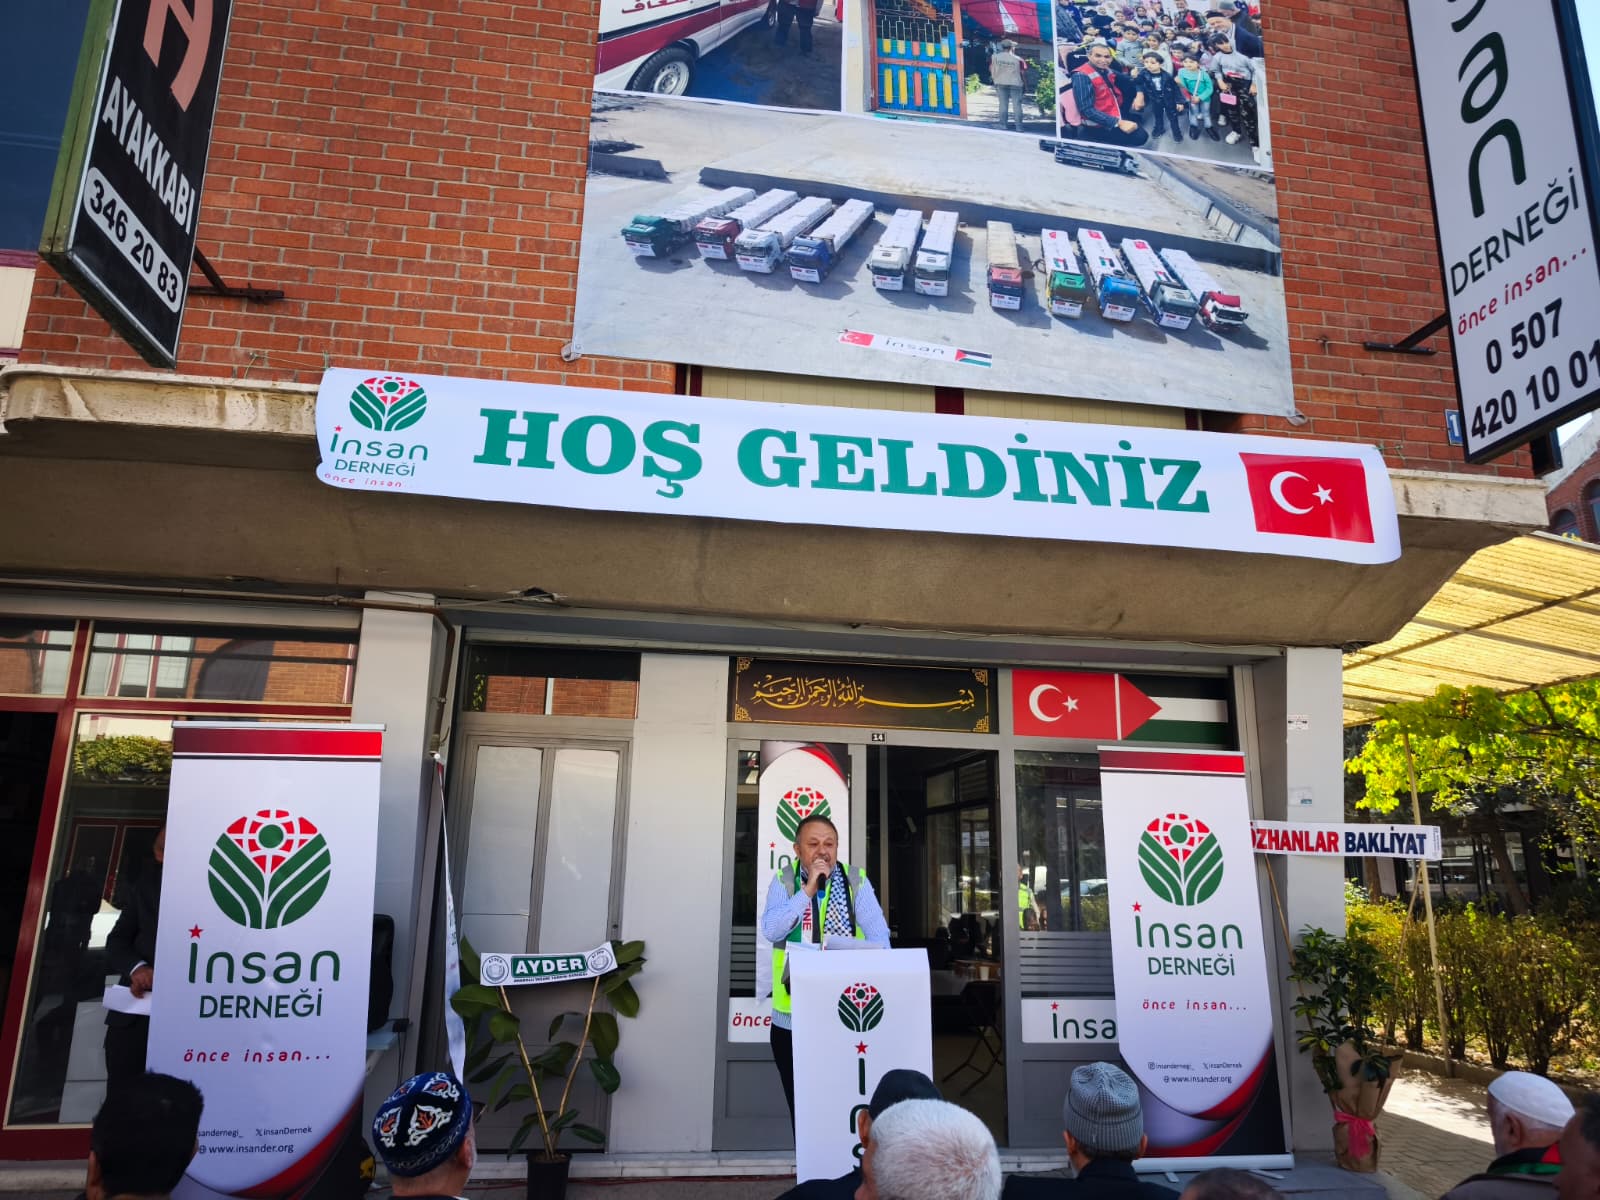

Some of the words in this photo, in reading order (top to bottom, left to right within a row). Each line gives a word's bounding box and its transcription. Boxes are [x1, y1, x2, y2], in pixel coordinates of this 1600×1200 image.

[1450, 0, 1526, 218] an
[103, 76, 196, 235] AYAKKABI
[90, 179, 128, 243] 346
[130, 230, 154, 274] 20
[157, 261, 178, 304] 83
[1450, 167, 1579, 296] DERNEĞİ
[1458, 297, 1497, 336] önce
[1486, 339, 1502, 375] 0
[1511, 297, 1562, 360] 507
[1471, 389, 1517, 440] 420
[1525, 365, 1560, 411] 10
[334, 459, 416, 477] DERNEĞİ
[473, 407, 702, 499] HOŞ
[737, 427, 1210, 514] GELDİNİZ
[1344, 826, 1427, 855] BAKLİYAT
[516, 958, 583, 974] AYDER
[1148, 953, 1235, 976] DERNEĞİ
[199, 987, 322, 1018] DERNEĞİ
[1142, 999, 1175, 1010] önce
[183, 1049, 230, 1062] önce
[208, 1143, 294, 1154] www.insander.org
